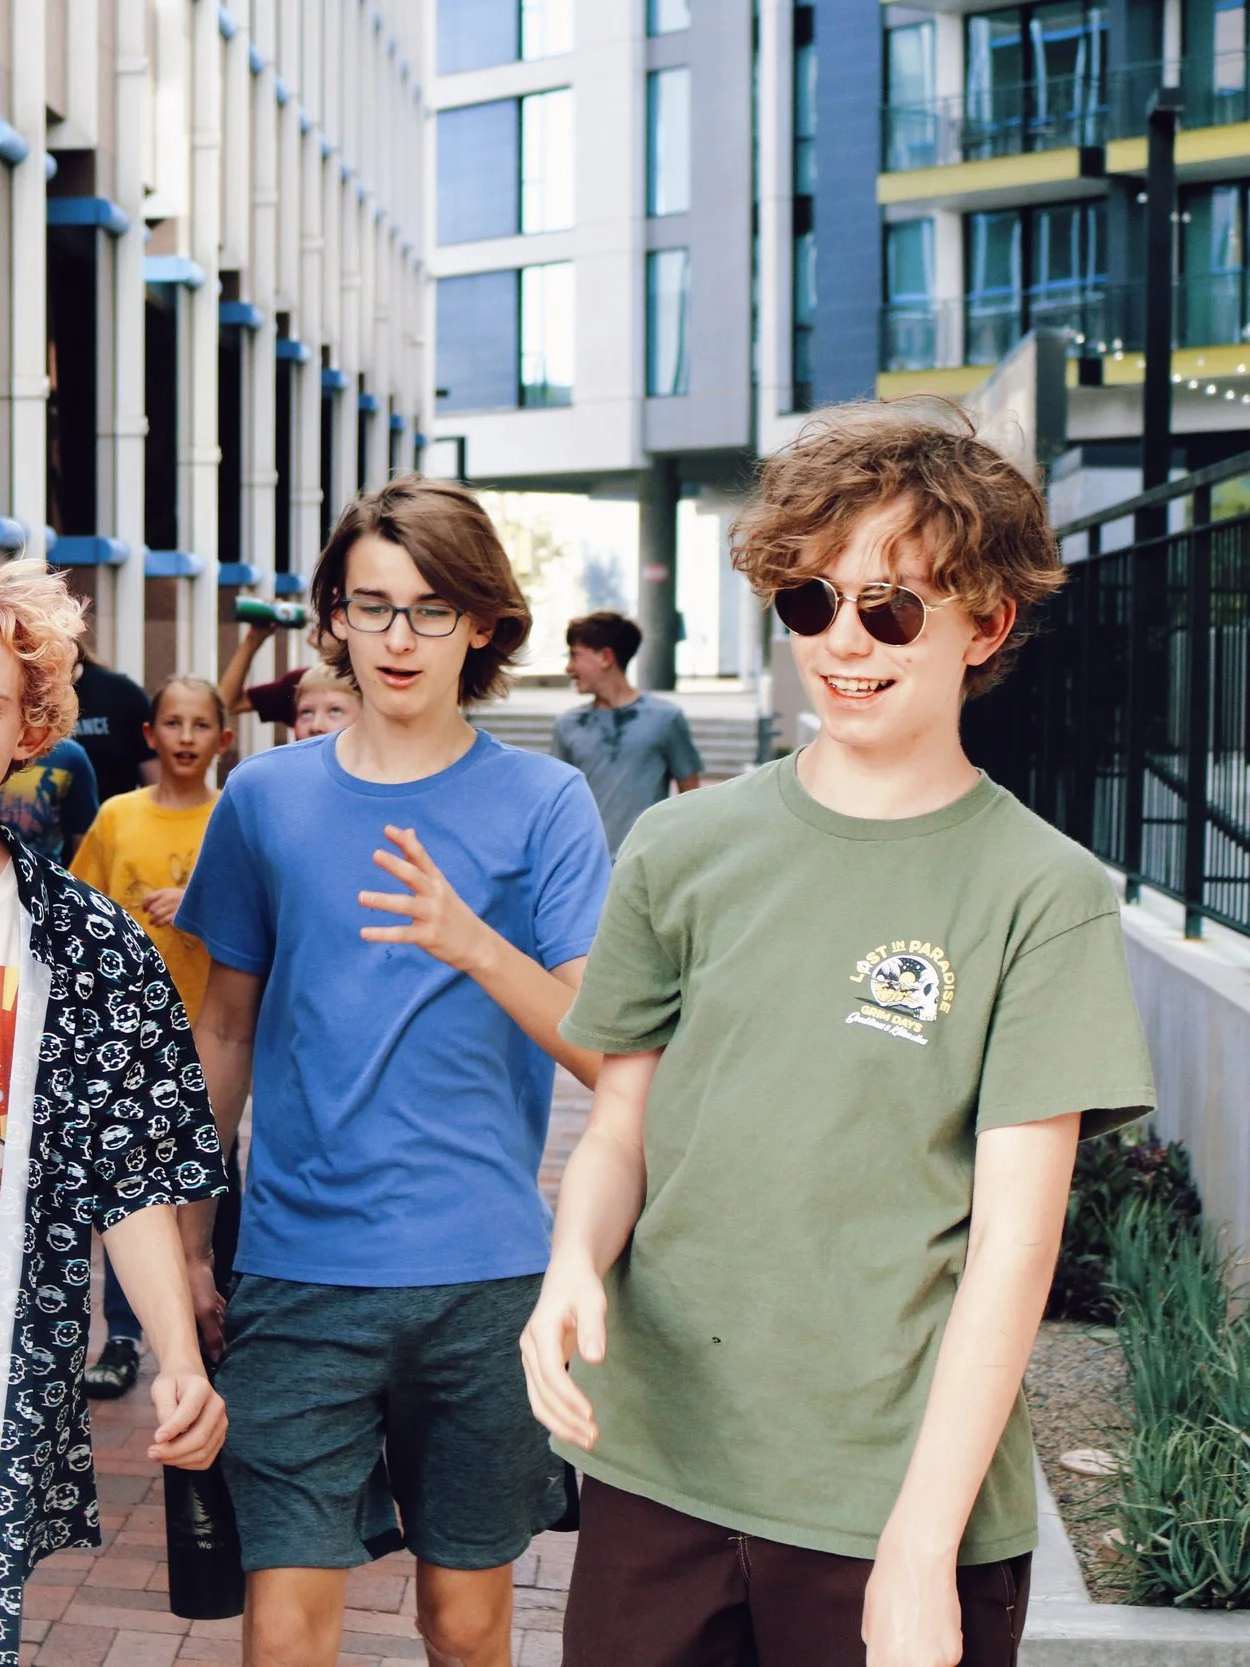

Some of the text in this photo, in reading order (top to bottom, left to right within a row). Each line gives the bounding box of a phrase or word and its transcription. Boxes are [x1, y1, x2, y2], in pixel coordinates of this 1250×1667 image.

[75, 717, 110, 736] ANCE
[891, 940, 906, 953] IN
[909, 940, 954, 1013] PARADISE
[861, 1005, 922, 1032] GRIM DAYS
